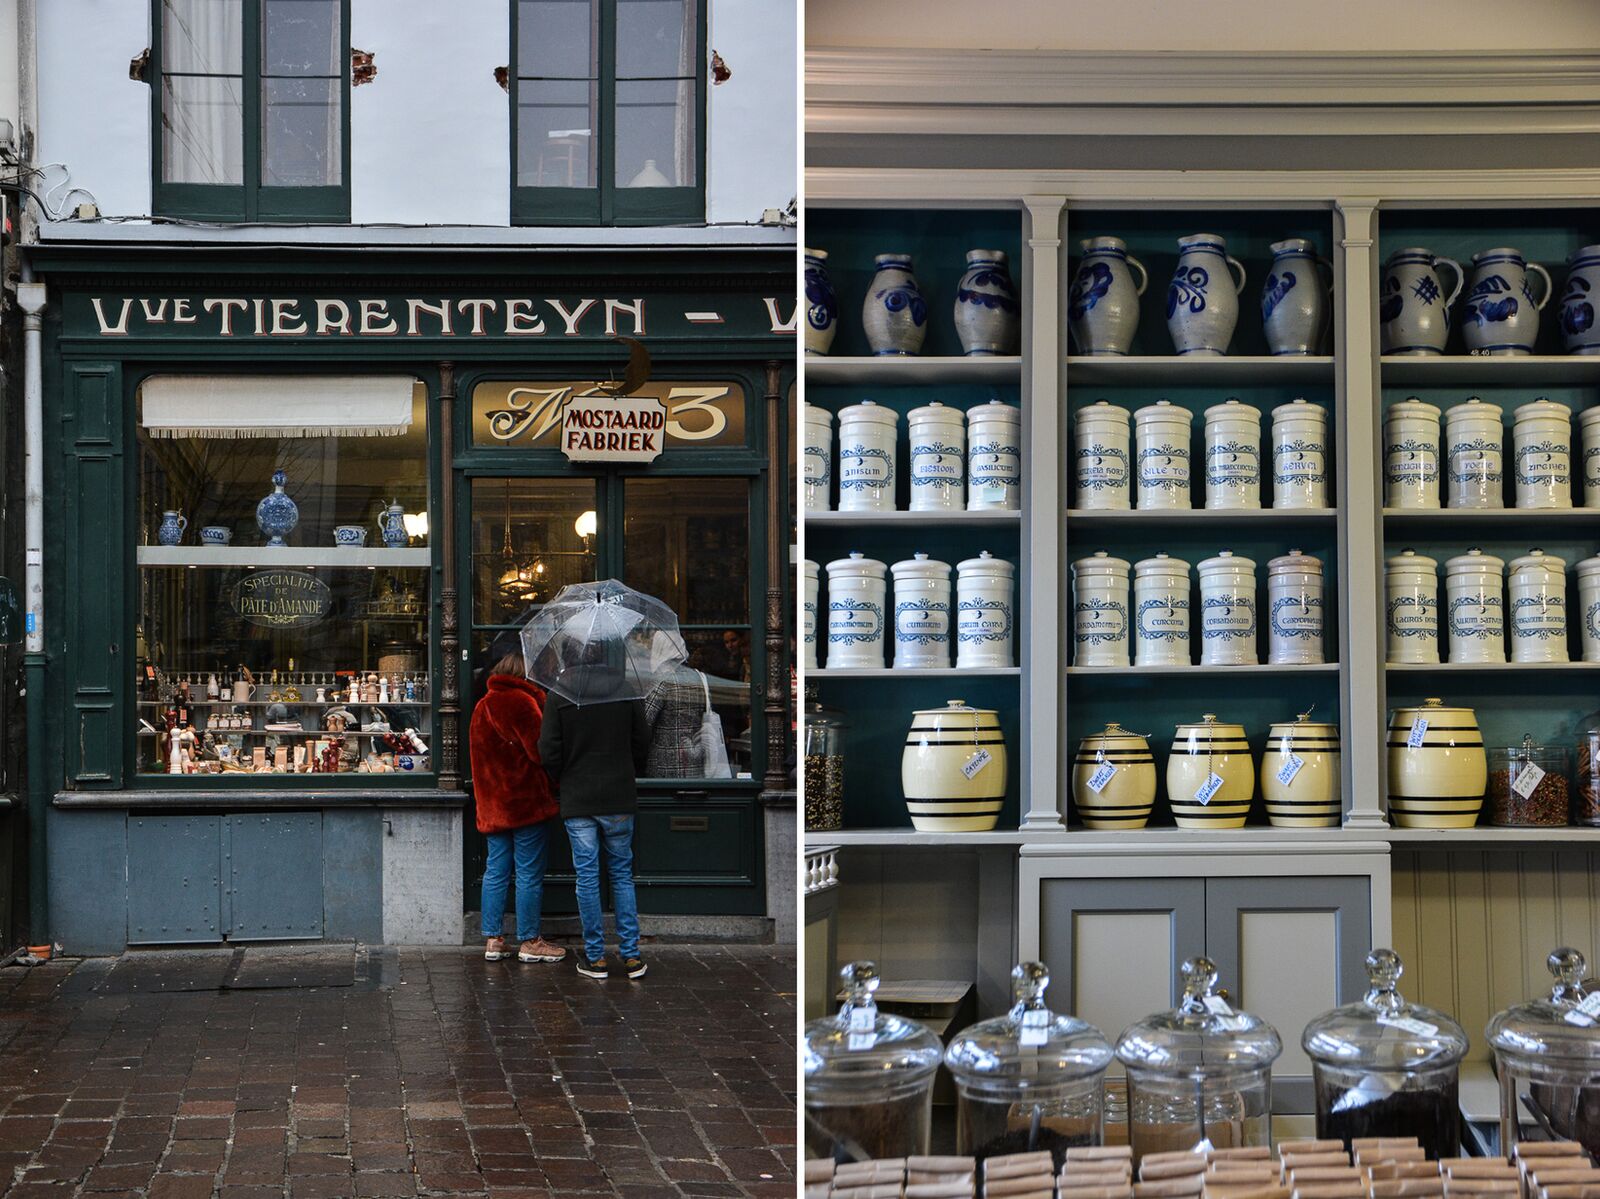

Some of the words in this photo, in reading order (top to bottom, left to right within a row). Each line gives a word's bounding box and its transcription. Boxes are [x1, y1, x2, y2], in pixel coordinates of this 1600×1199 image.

[203, 298, 646, 336] TIERENTEYN
[564, 409, 664, 430] MOSTAARD
[664, 386, 729, 440] 3
[566, 431, 657, 452] FABRIEK
[275, 587, 288, 595] DE
